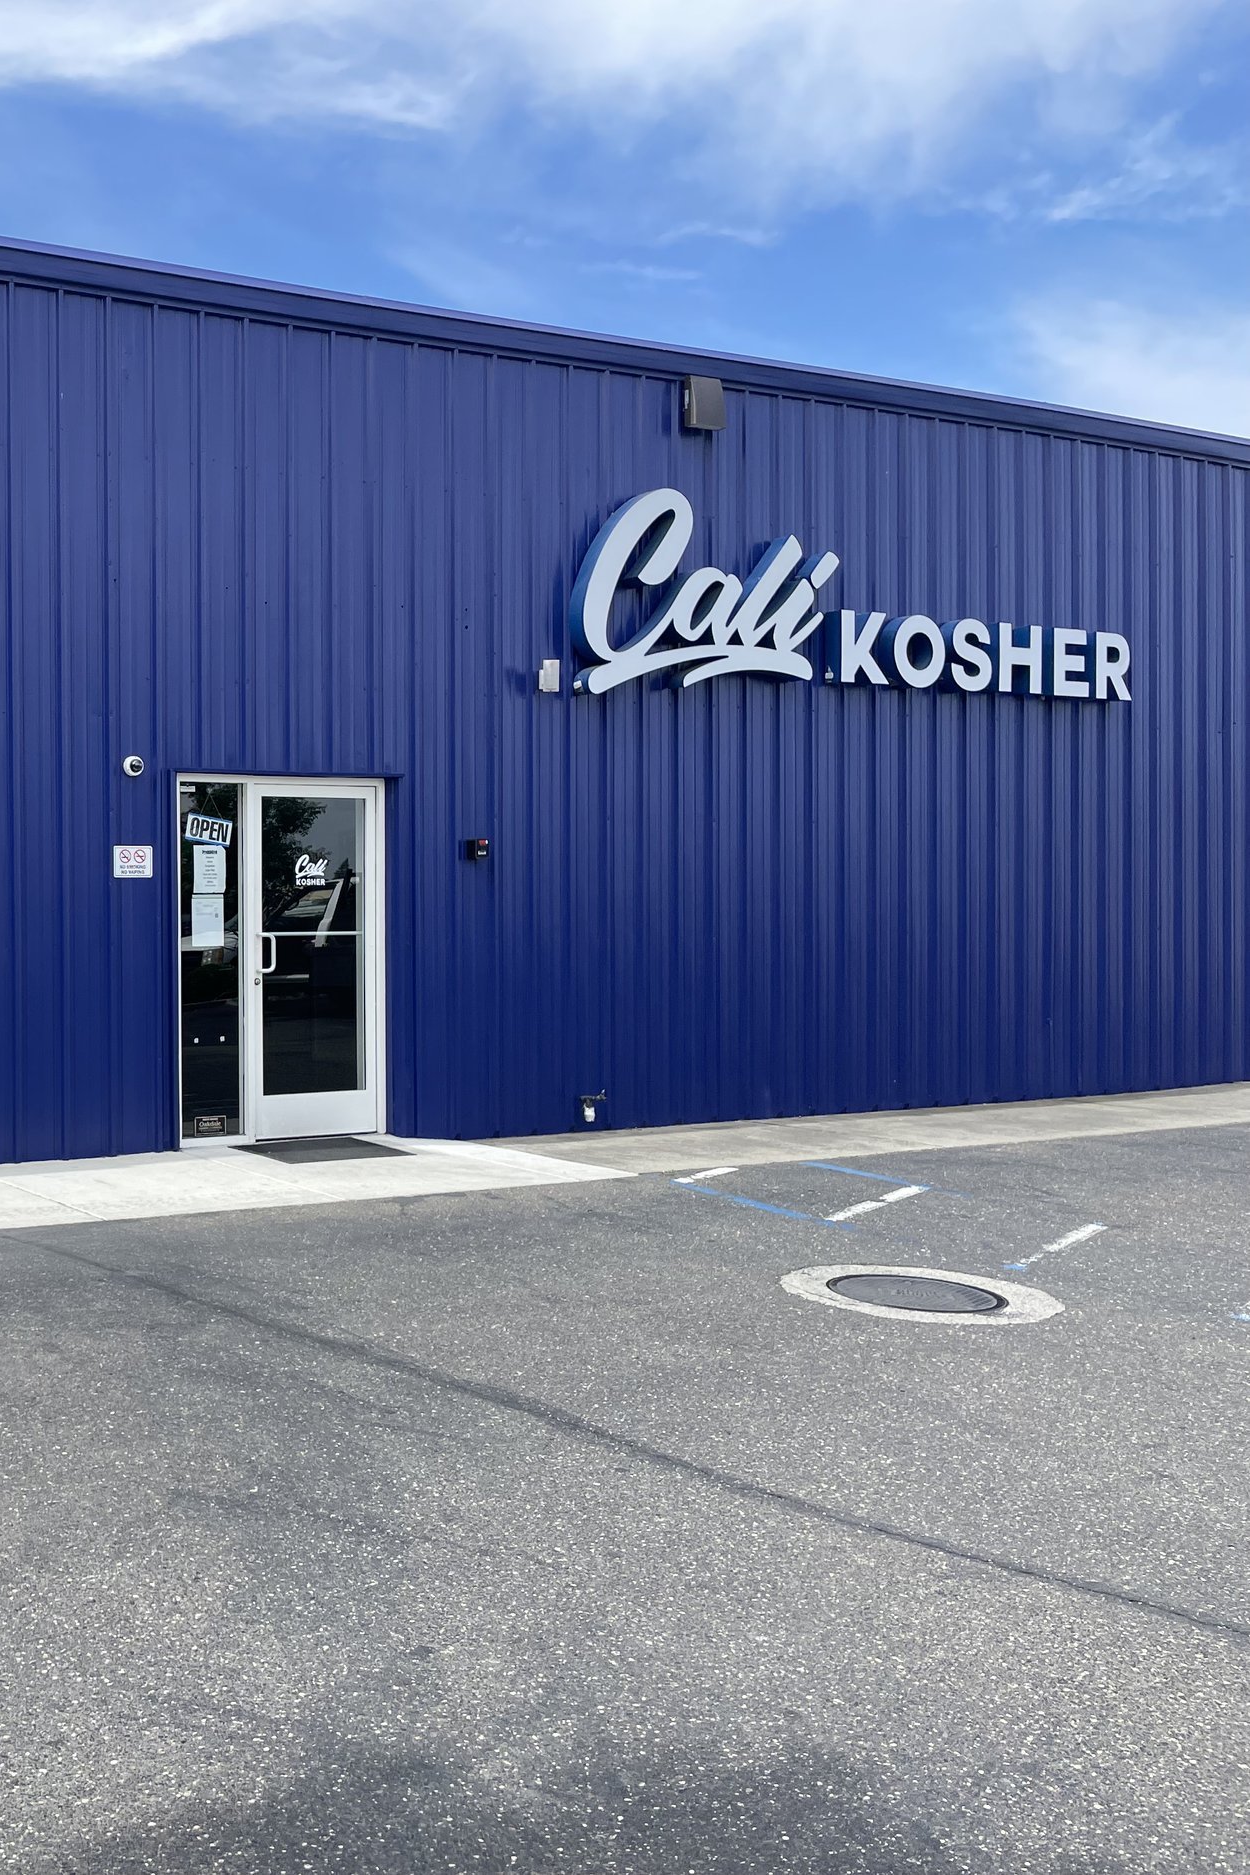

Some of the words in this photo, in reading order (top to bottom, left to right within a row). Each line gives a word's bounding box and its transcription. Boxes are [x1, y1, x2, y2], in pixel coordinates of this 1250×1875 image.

[580, 487, 840, 694] Cali
[839, 609, 1133, 701] KOSHER
[190, 817, 230, 843] OPEN
[295, 854, 328, 878] Cali
[295, 878, 326, 886] KOSHER
